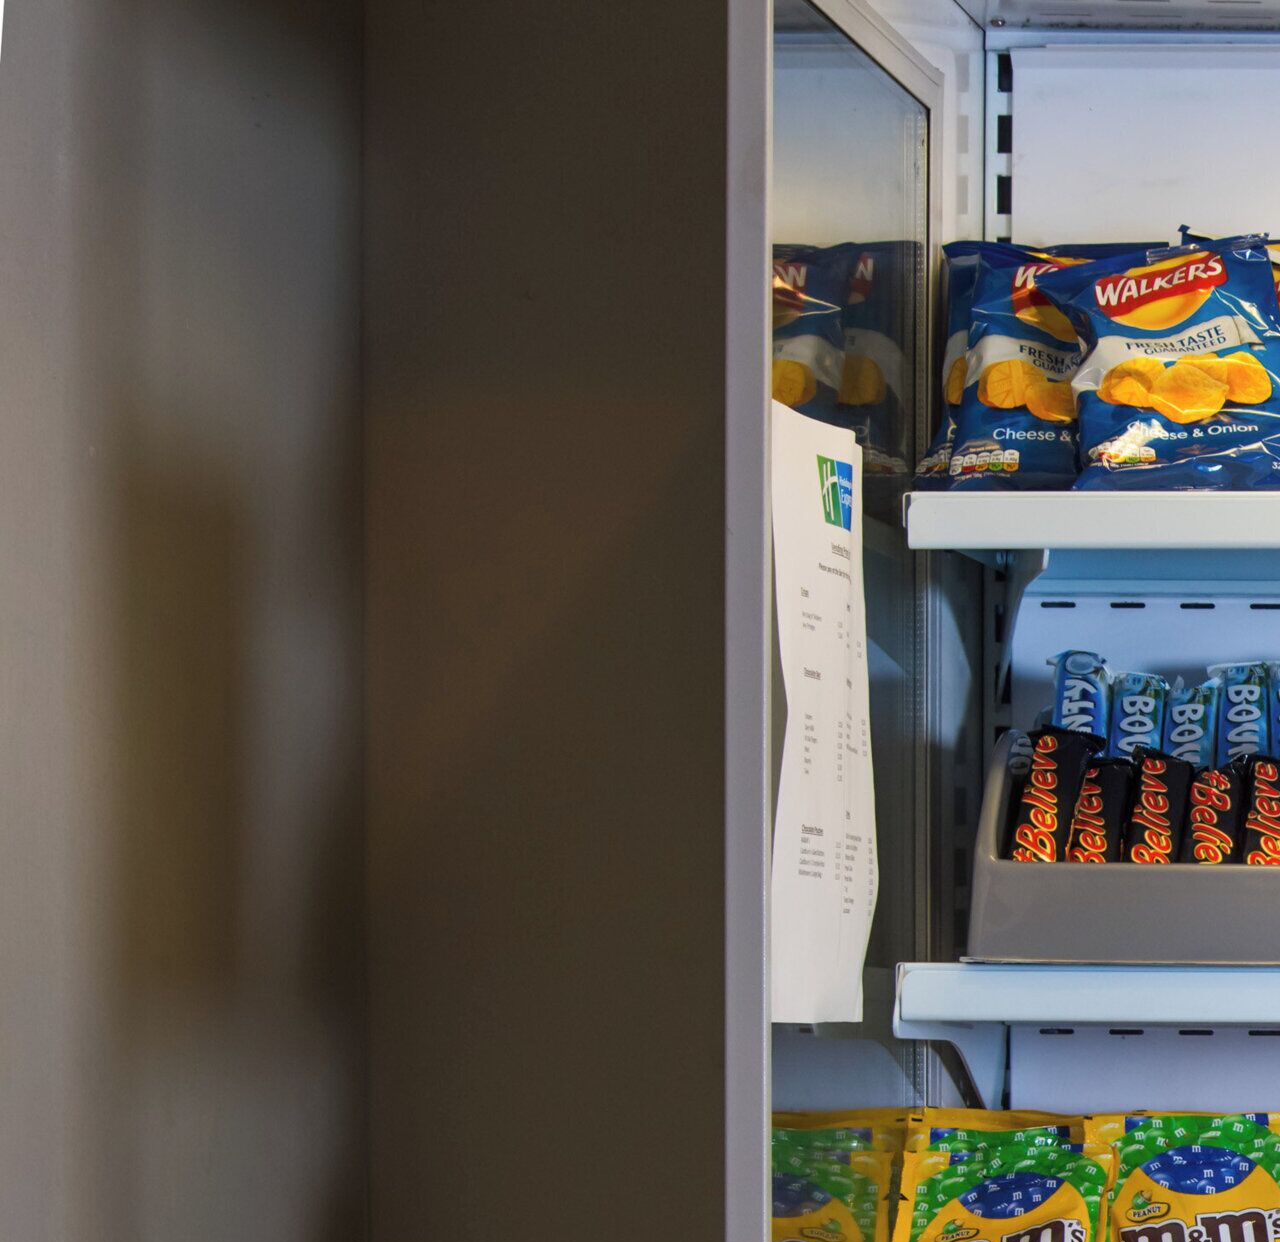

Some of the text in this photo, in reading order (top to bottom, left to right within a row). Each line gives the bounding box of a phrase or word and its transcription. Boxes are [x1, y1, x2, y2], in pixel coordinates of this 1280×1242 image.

[1095, 257, 1224, 308] WALKERS
[993, 428, 1057, 442] Cheese
[1205, 422, 1259, 436] Onion
[1132, 1205, 1162, 1218] PEANUT
[941, 1231, 971, 1241] PEANUT
